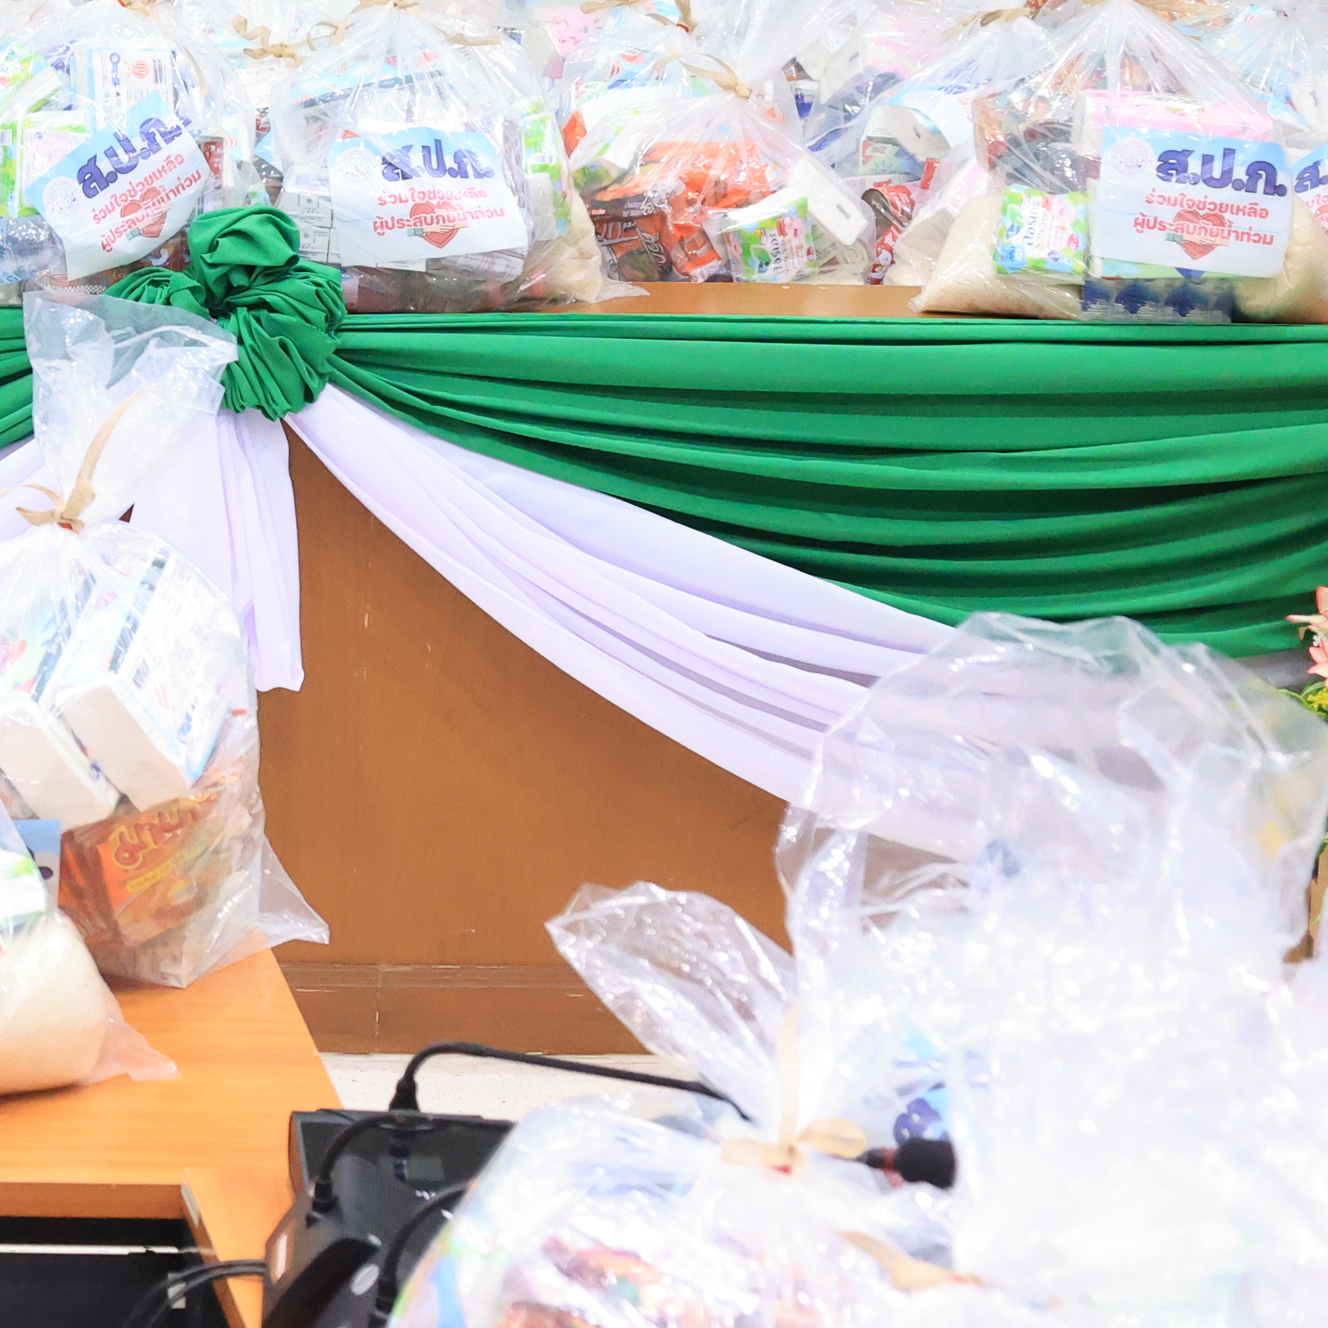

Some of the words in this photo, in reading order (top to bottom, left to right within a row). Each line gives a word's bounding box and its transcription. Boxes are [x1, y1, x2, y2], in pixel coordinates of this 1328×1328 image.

[76, 117, 183, 199] ส.ป.ก.
[381, 138, 495, 182] ส.ป.ก.
[1155, 147, 1288, 198] ส.ป.ก.
[92, 152, 185, 225] ร่วมใจช่วยเหลือ
[1145, 188, 1270, 220] ร่วมใจช่วยเหลือ
[1133, 212, 1275, 247] ผู้ประสบภัยน้ำท่วม
